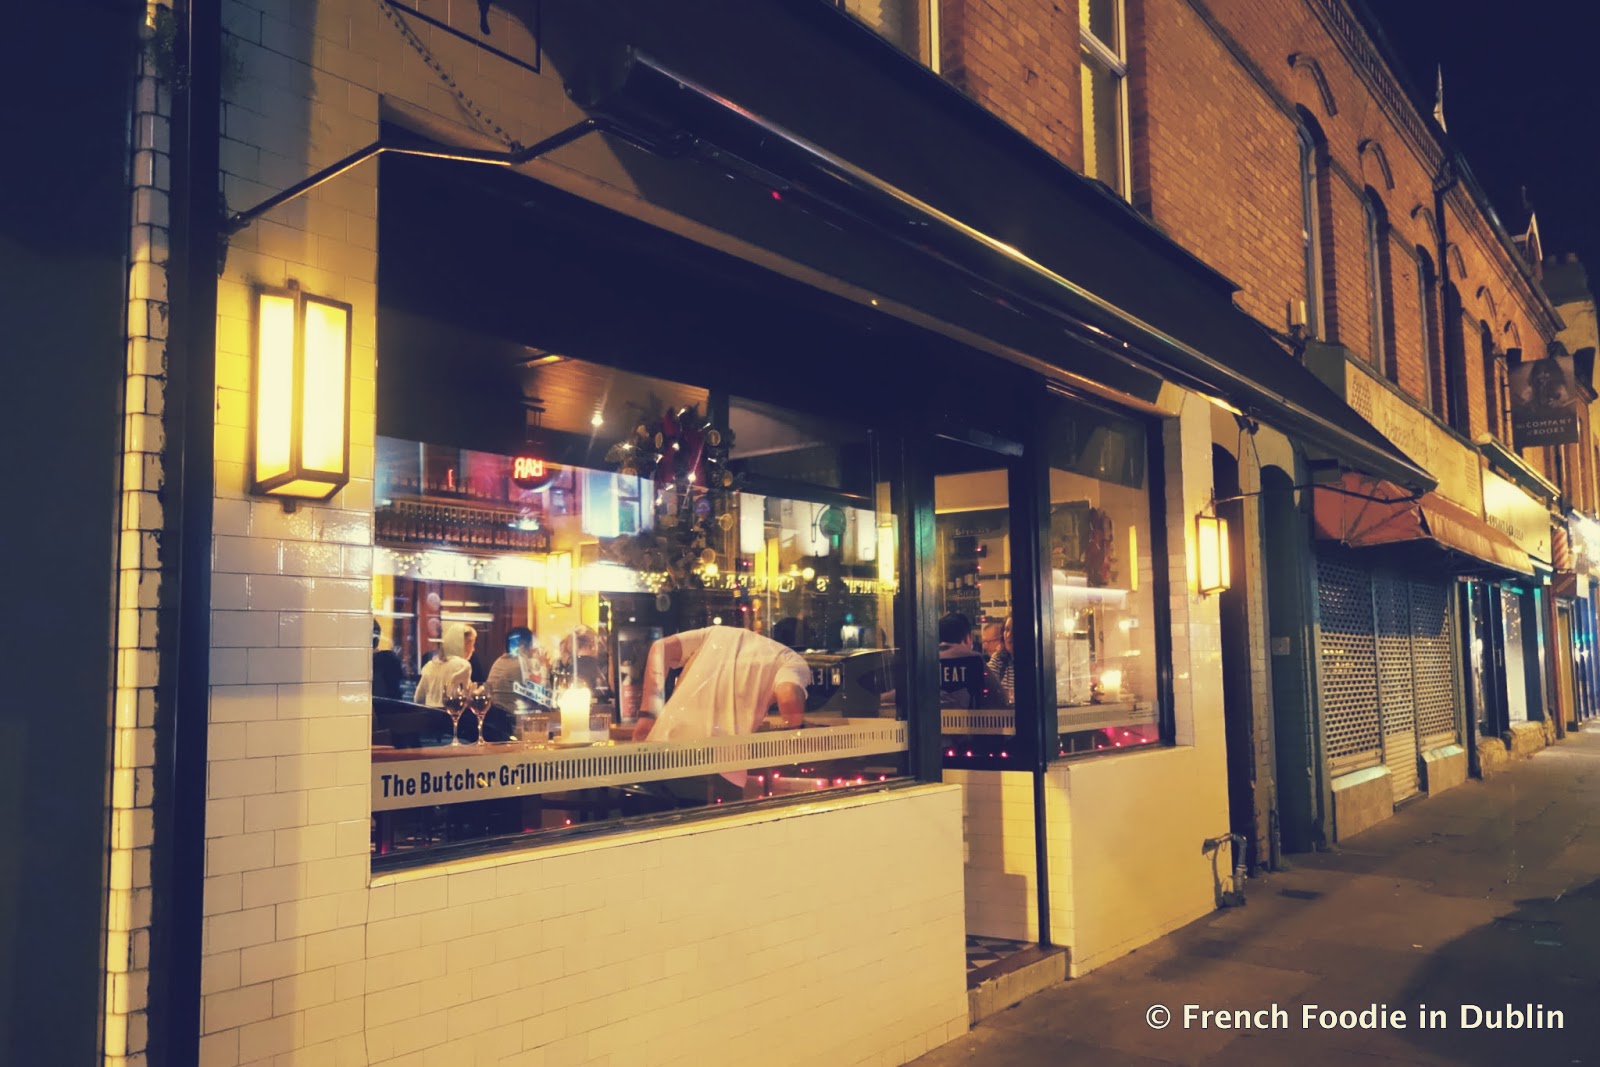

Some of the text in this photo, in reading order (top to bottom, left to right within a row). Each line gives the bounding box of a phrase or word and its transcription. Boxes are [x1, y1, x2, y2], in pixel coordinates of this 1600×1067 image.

[1525, 418, 1572, 428] COMPANY
[381, 774, 416, 798] The
[420, 768, 496, 795] Butcher
